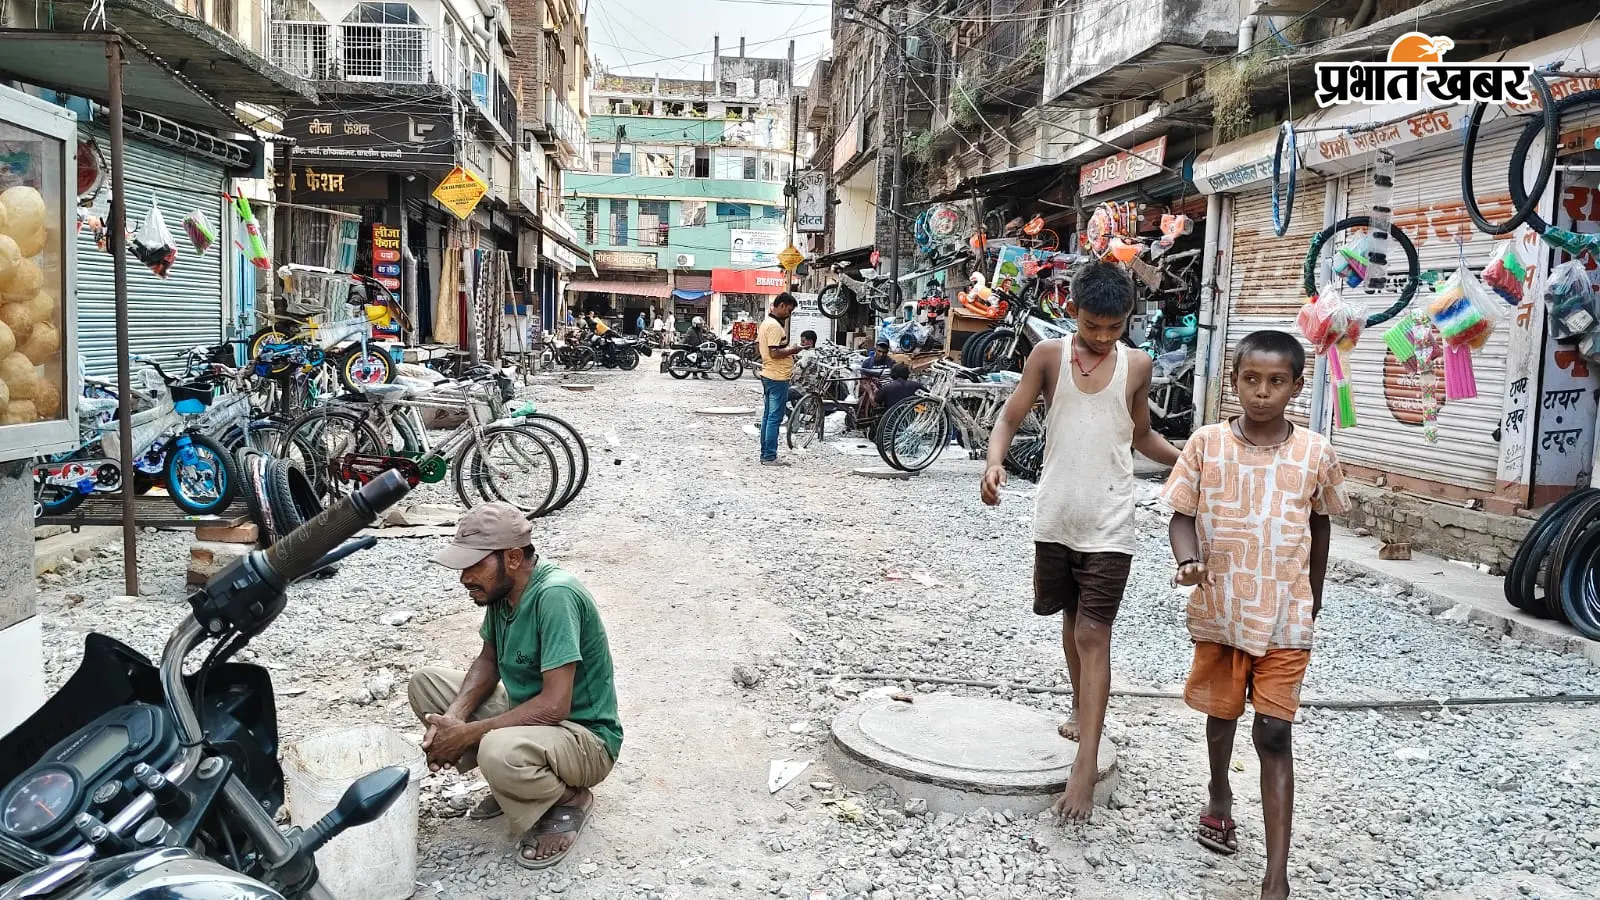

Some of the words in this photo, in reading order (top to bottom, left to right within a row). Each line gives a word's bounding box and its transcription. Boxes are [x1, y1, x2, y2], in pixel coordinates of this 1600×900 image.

[308, 118, 332, 135] लीजा
[1406, 110, 1453, 138] स्टोर
[306, 164, 345, 192] फैशन
[1091, 154, 1123, 185] शशि
[798, 213, 824, 226] होटल
[374, 225, 400, 238] लीजा
[755, 277, 785, 287] BEAUTY
[1509, 377, 1529, 397] टायर
[1543, 387, 1586, 411] टायर
